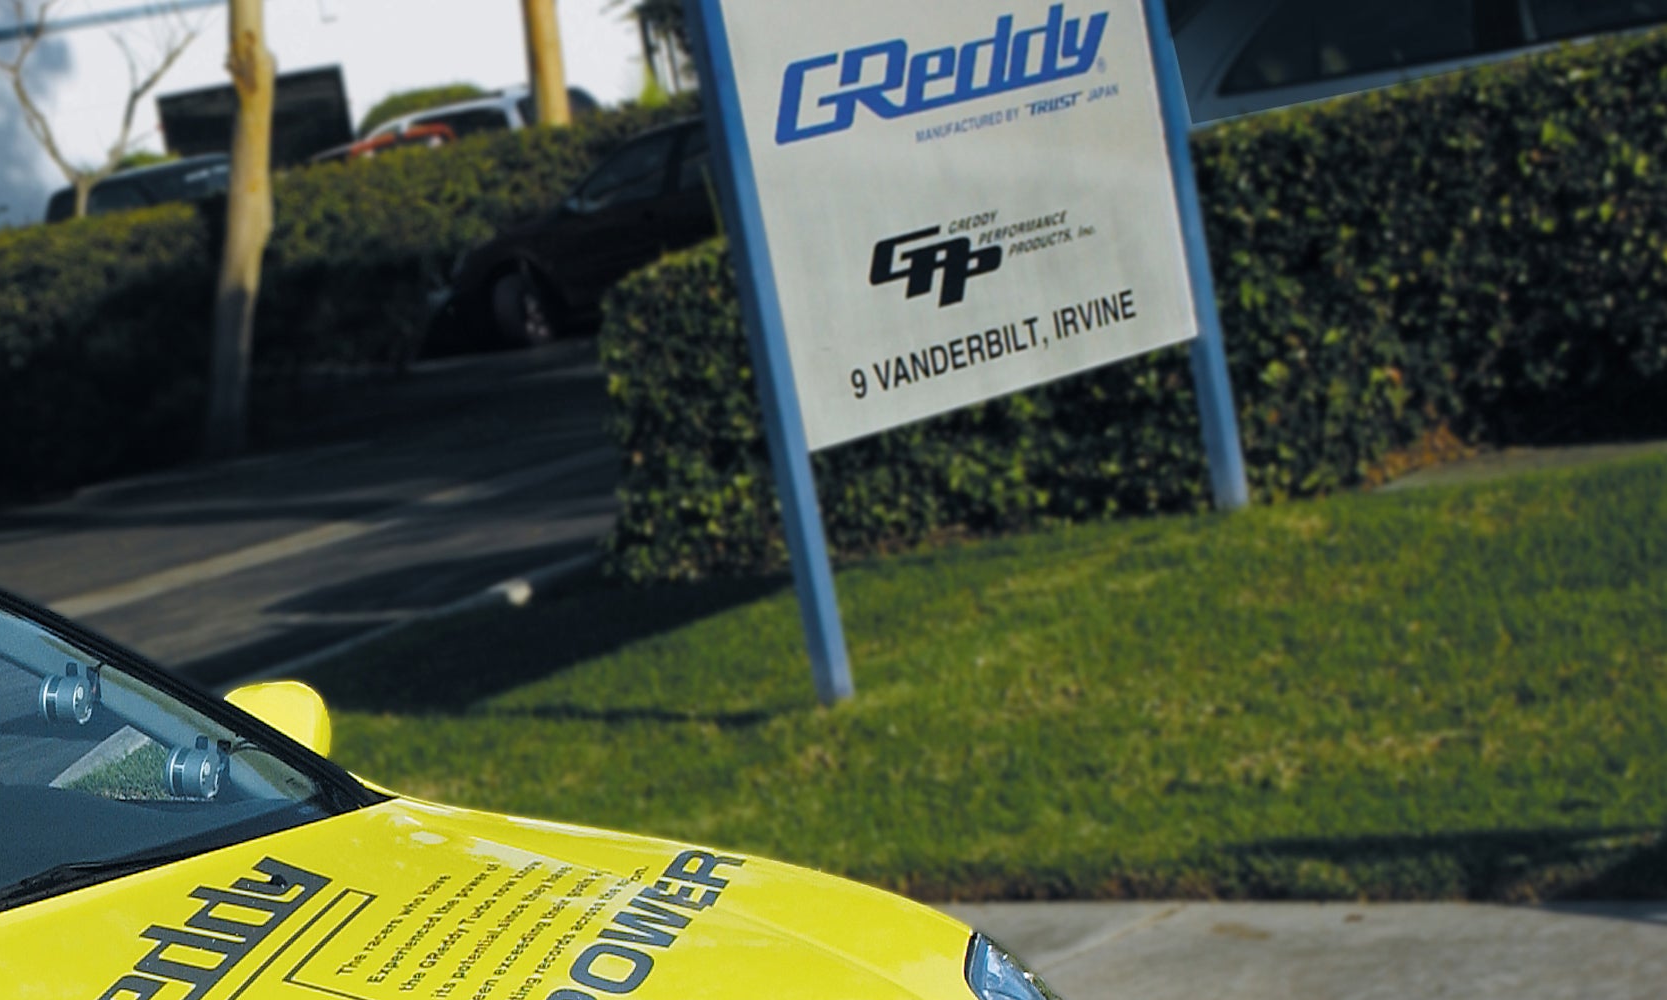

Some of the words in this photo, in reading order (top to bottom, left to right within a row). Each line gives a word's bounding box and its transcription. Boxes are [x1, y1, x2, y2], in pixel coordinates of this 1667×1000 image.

[774, 2, 1110, 146] GReddy
[915, 110, 1003, 143] MANUFACTURED
[1005, 107, 1020, 123] BY
[1087, 83, 1119, 102] JAPAN
[948, 209, 999, 235] GREDDY
[978, 210, 1068, 246] PERFORMANCE
[849, 368, 869, 401] 9
[872, 317, 1049, 393] VANDERBILT,
[1052, 288, 1139, 344] IRVINE
[336, 953, 368, 976] The
[364, 917, 404, 952] racers
[399, 895, 426, 916] who
[418, 874, 452, 896] have
[366, 915, 443, 984] Experienced
[434, 898, 461, 916] the
[455, 872, 491, 898] power
[398, 971, 427, 993] the
[419, 927, 471, 970] GReddy
[458, 898, 497, 927] Turbo
[493, 880, 518, 899] now
[493, 919, 552, 977] exceeding
[534, 932, 576, 975] records
[431, 981, 457, 999] its
